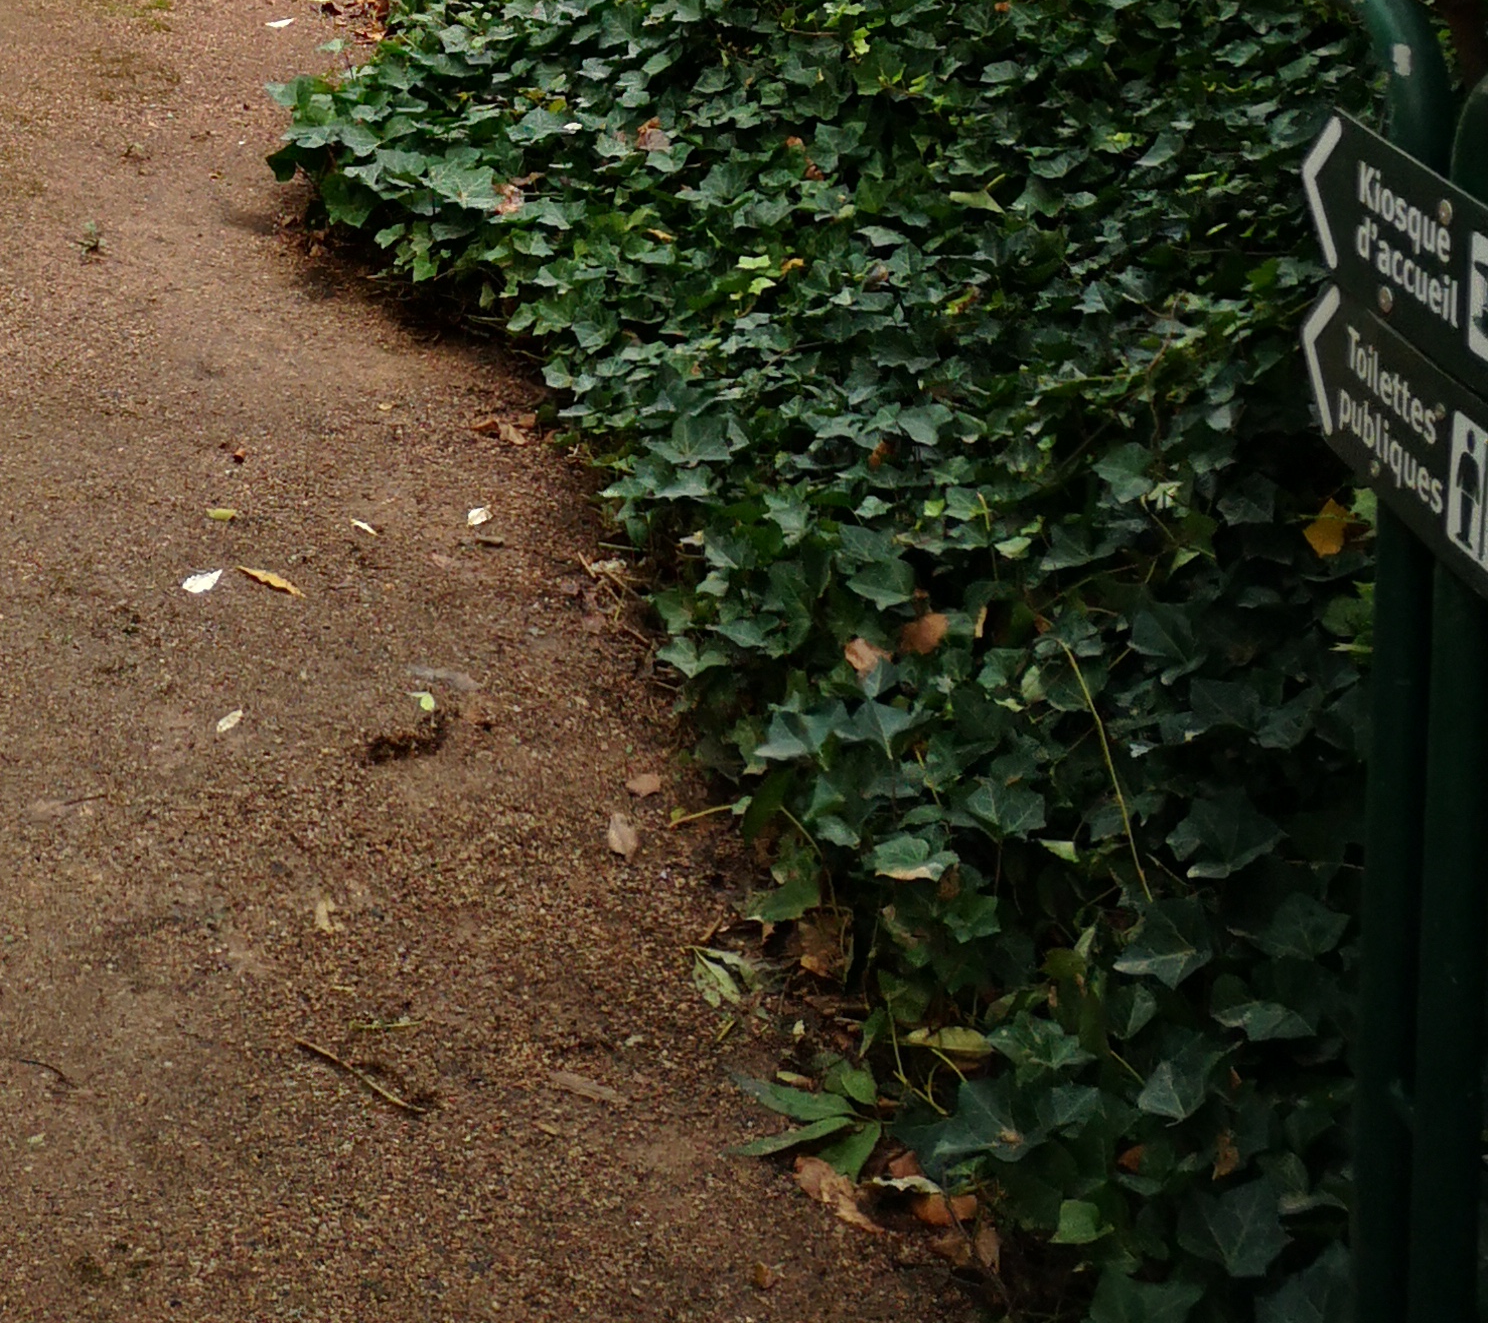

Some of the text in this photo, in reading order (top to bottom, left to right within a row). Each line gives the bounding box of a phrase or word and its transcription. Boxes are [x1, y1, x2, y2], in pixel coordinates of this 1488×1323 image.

[1357, 159, 1452, 264] Kiosque
[1356, 216, 1459, 329] d'accueil
[1346, 324, 1438, 446] Toilettes
[1338, 388, 1444, 515] publiques
